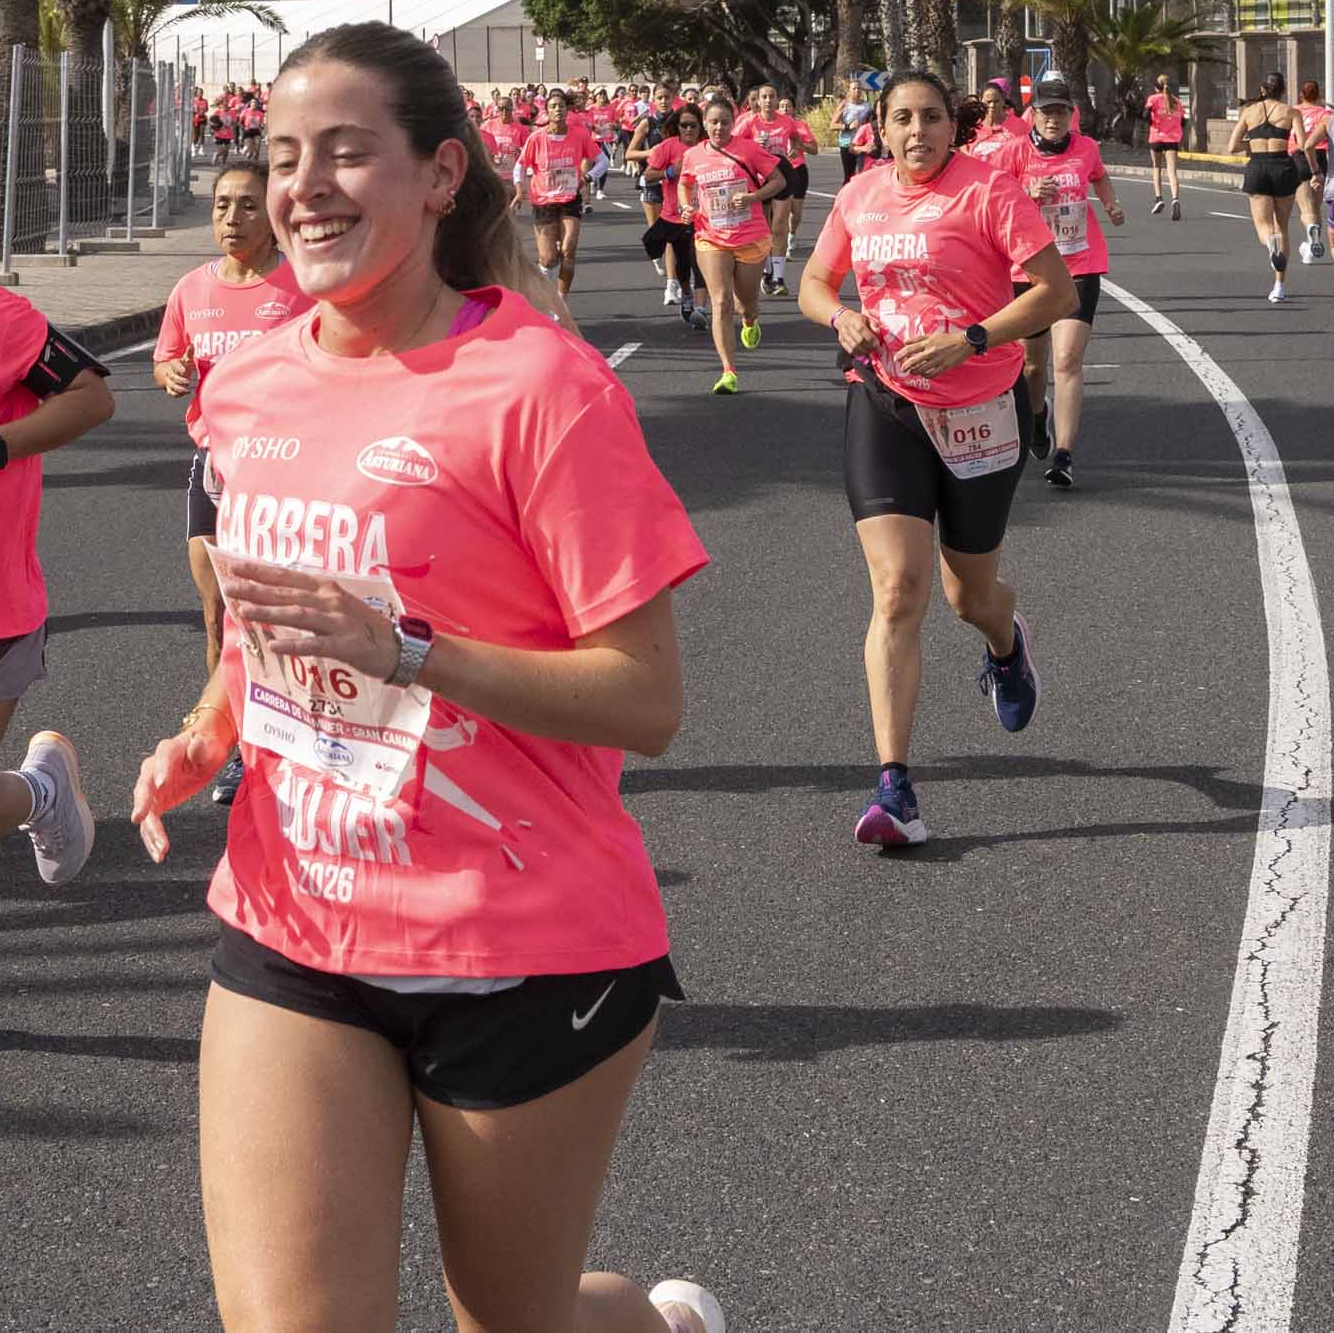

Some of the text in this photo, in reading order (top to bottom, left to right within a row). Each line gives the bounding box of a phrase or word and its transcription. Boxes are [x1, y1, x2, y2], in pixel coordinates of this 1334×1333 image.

[1030, 173, 1081, 187] CERA
[852, 233, 929, 262] CARRERA
[190, 307, 225, 321] OYSHO
[193, 330, 263, 358] CARR
[953, 424, 991, 444] 016
[232, 437, 301, 460] OYSHO
[362, 450, 430, 479] ASTURIANA
[217, 490, 391, 577] CARRERA
[290, 655, 357, 700] 016
[254, 687, 291, 713] CARRERA
[264, 723, 296, 743] OYSHO
[298, 861, 356, 903] 2026
